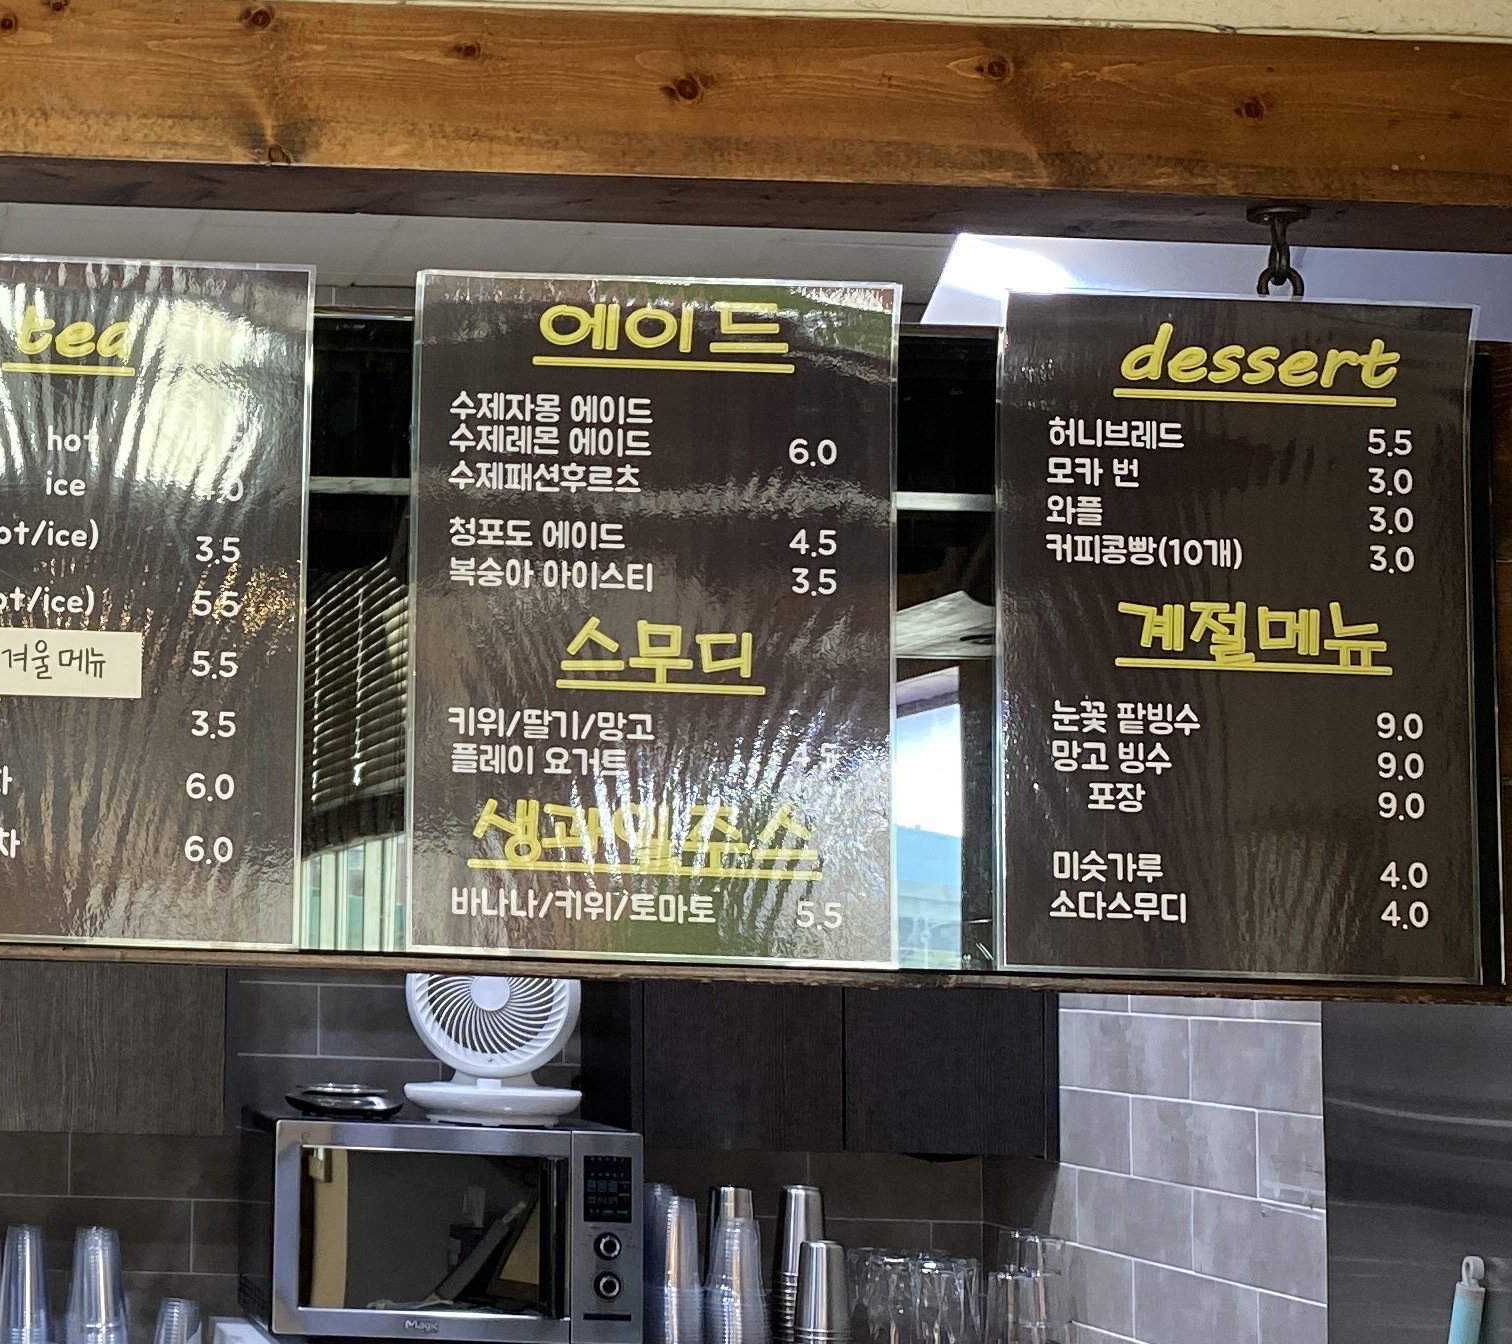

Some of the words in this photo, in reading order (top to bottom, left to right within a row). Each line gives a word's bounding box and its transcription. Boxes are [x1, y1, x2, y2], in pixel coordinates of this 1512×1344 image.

[15, 305, 135, 358] tea
[540, 303, 789, 353] 에이드
[1121, 323, 1400, 390] dessert
[449, 391, 560, 424] 수제자몽
[570, 394, 653, 425] 에이드
[449, 425, 560, 455] 수제레몬
[570, 426, 652, 457] 에이드
[789, 439, 837, 466] 6.0
[1048, 418, 1185, 451] 허니브레드
[45, 472, 86, 497] ice
[448, 461, 641, 494] 수제패션후르츠
[1046, 459, 1102, 487] 모카
[1113, 459, 1139, 488] 번
[1046, 497, 1102, 526] 와플
[449, 517, 532, 549] 청포도
[543, 520, 625, 550] 에이드
[1045, 534, 1242, 569] 커피콩빵(10개)
[449, 557, 531, 589] 복숭아
[544, 559, 653, 592] 아이스티
[561, 617, 752, 684] 스무디
[1117, 602, 1387, 667] 계절메뉴
[1, 640, 51, 680] 겨울
[58, 648, 106, 678] 메뉴
[191, 651, 238, 679] 5.5
[448, 708, 654, 742] 키위/딸기/망고
[1051, 701, 1107, 733] 눈꽃
[1117, 704, 1200, 737] 팥빙수
[451, 743, 533, 776] 플레이
[544, 747, 626, 776] 요거트
[1051, 742, 1108, 772] 망고
[1118, 742, 1172, 774] 빙수
[1088, 784, 1144, 813] 포장
[185, 836, 234, 863] 6.0
[1053, 852, 1163, 883] 미숫가루
[451, 887, 717, 924] 바나나/키위/토마토
[796, 902, 842, 929] 5.5
[1050, 891, 1188, 923] 소다스무디
[1381, 902, 1429, 929] 4.0
